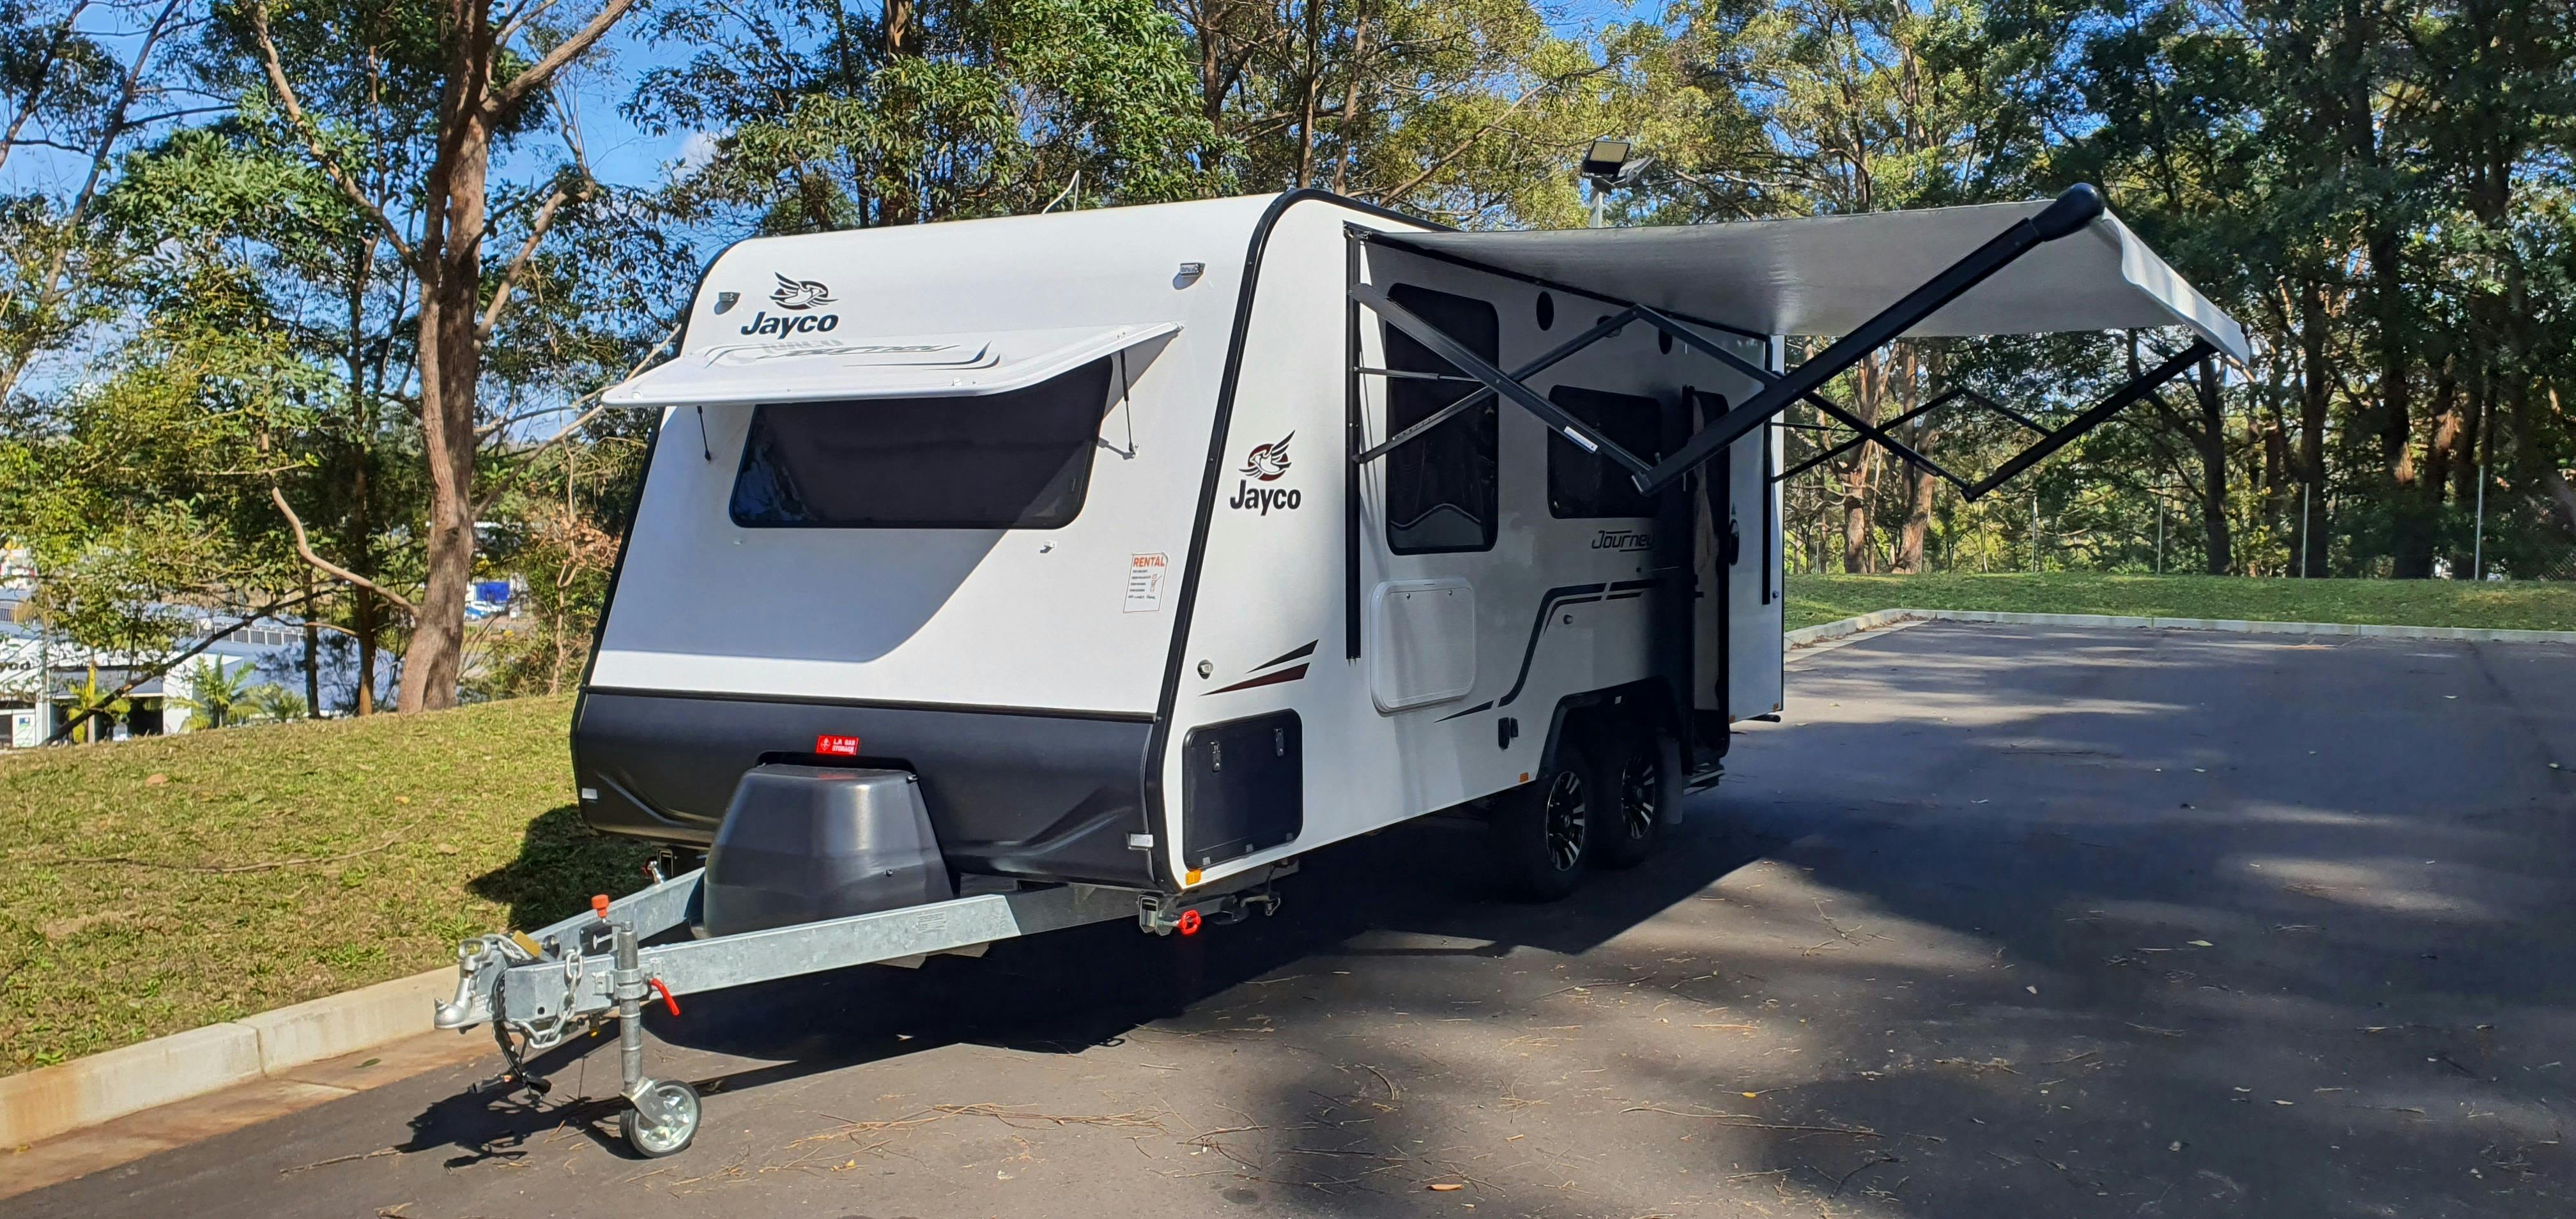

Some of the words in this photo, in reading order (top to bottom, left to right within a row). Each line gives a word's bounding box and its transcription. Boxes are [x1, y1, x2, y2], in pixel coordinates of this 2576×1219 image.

[740, 311, 839, 340] Jayco
[1230, 479, 1301, 516] Jayco
[1591, 530, 1655, 551] Journey
[1133, 556, 1165, 567] RENTAL
